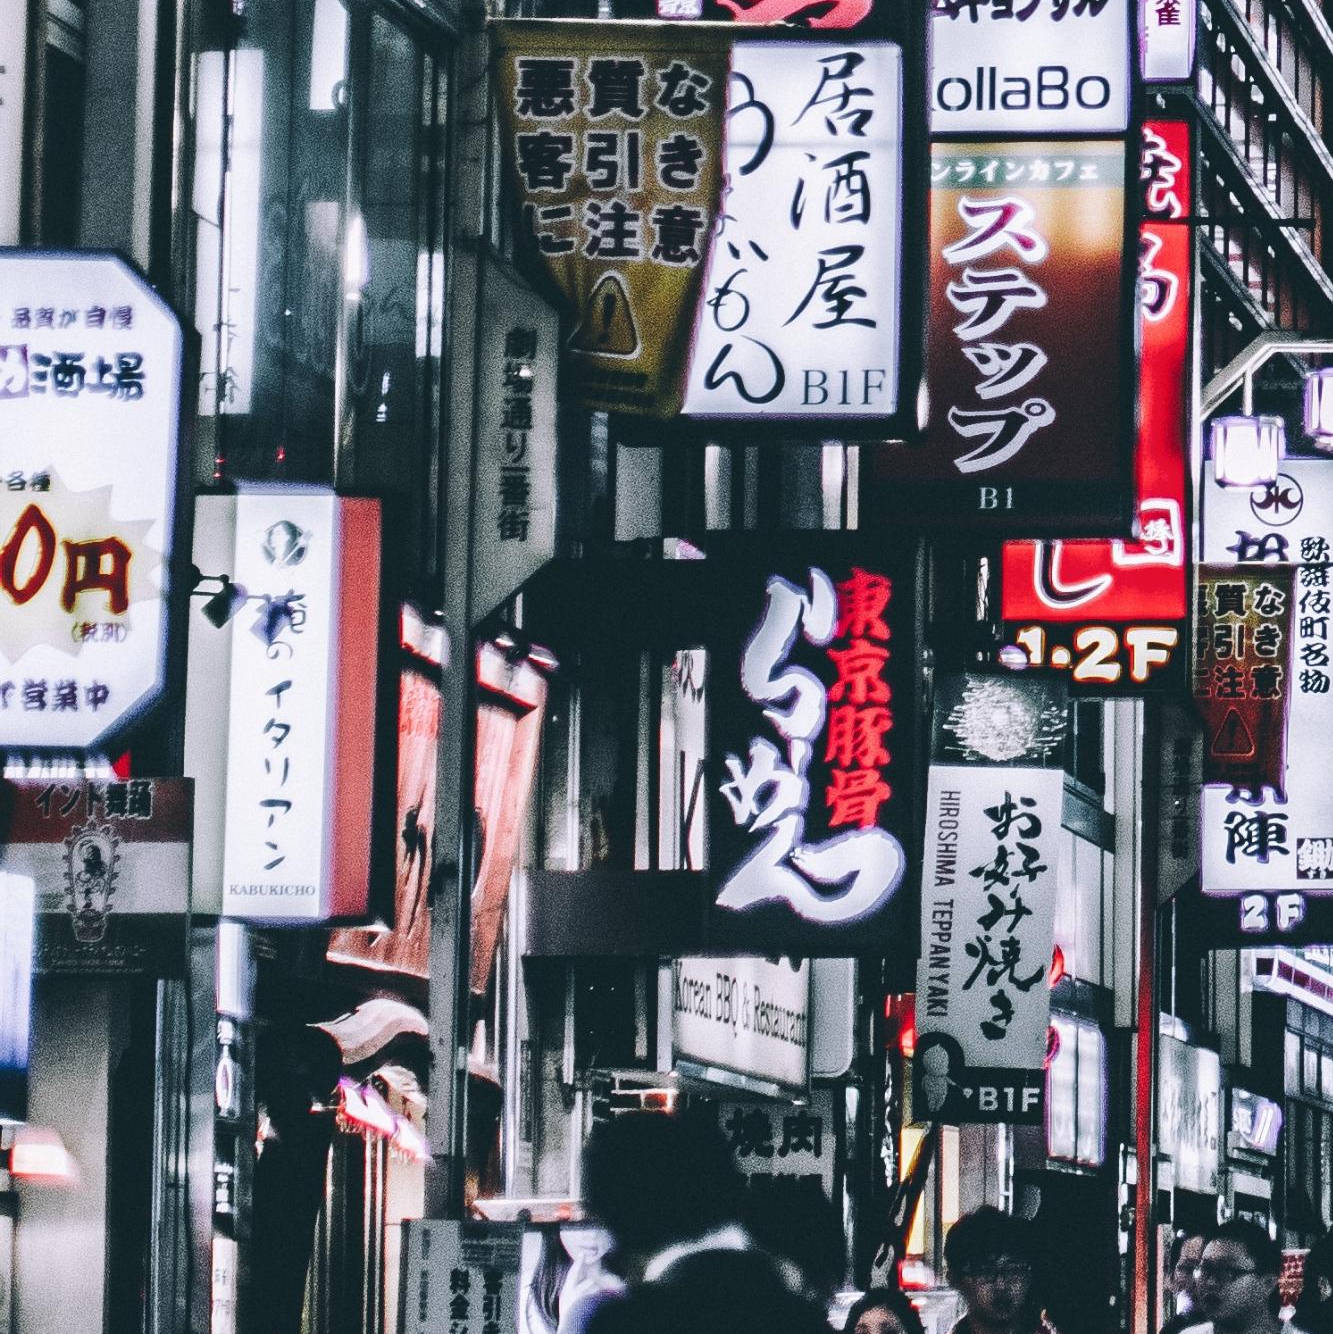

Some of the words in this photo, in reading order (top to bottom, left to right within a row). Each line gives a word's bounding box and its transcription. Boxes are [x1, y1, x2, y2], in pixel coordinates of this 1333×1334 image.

[514, 56, 711, 123] 悪質な
[935, 65, 1111, 112] ollaBo
[516, 130, 707, 194] 客引き
[781, 51, 878, 330] 居酒屋
[522, 200, 709, 267] に注意
[942, 195, 1056, 475] ステップ
[801, 369, 887, 405] B1F
[978, 486, 1014, 510] B1
[1299, 536, 1331, 695] 歌舞伎町名物
[825, 567, 892, 830] 東京豚骨
[934, 789, 961, 888] HIROSHIMA
[228, 883, 317, 898] KABUKICHO
[961, 790, 1048, 1041] お好み焼き
[1239, 894, 1306, 931] 2F
[925, 897, 954, 1018] TEPPANYAKI
[673, 961, 712, 1021] Korean
[715, 972, 740, 1039] BBQ
[753, 984, 806, 1051] Restauran
[978, 1086, 1040, 1111] B1F
